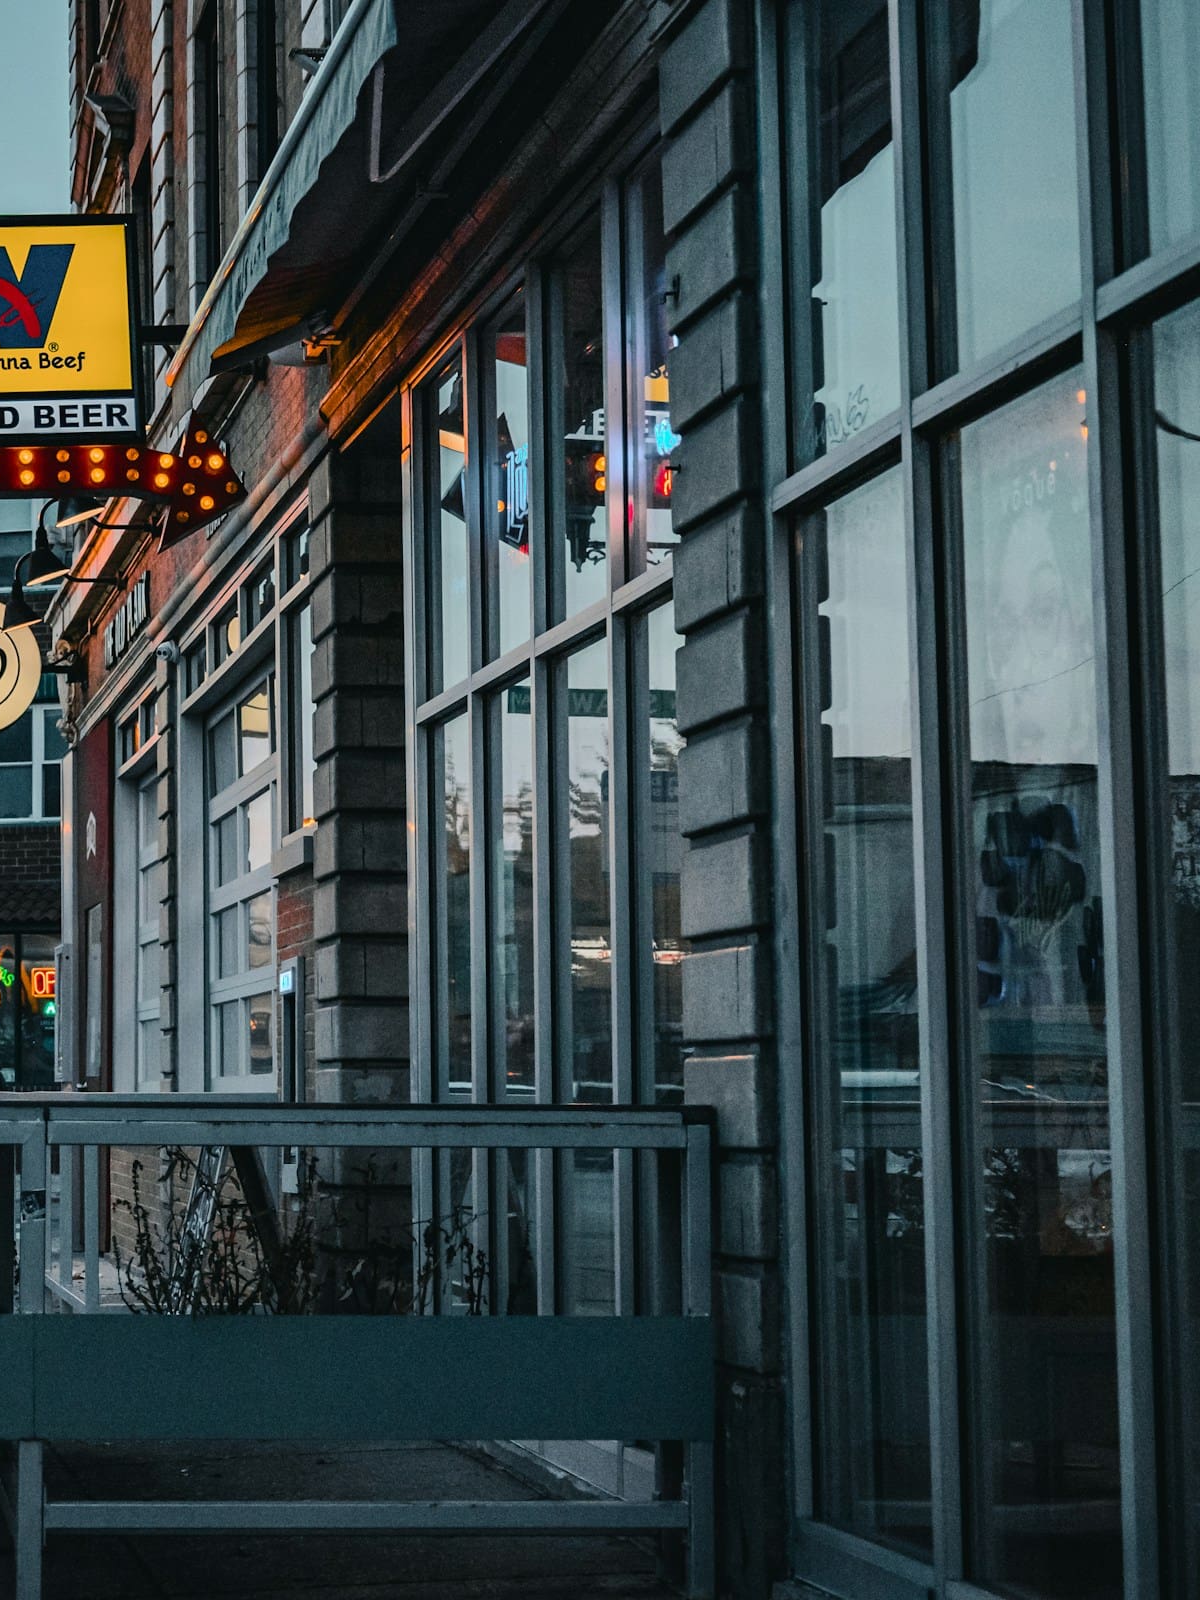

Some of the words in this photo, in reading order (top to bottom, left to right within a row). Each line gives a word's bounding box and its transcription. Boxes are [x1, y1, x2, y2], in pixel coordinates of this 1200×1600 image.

[38, 351, 86, 373] Beef
[33, 403, 130, 430] BEER
[33, 971, 56, 995] OP
